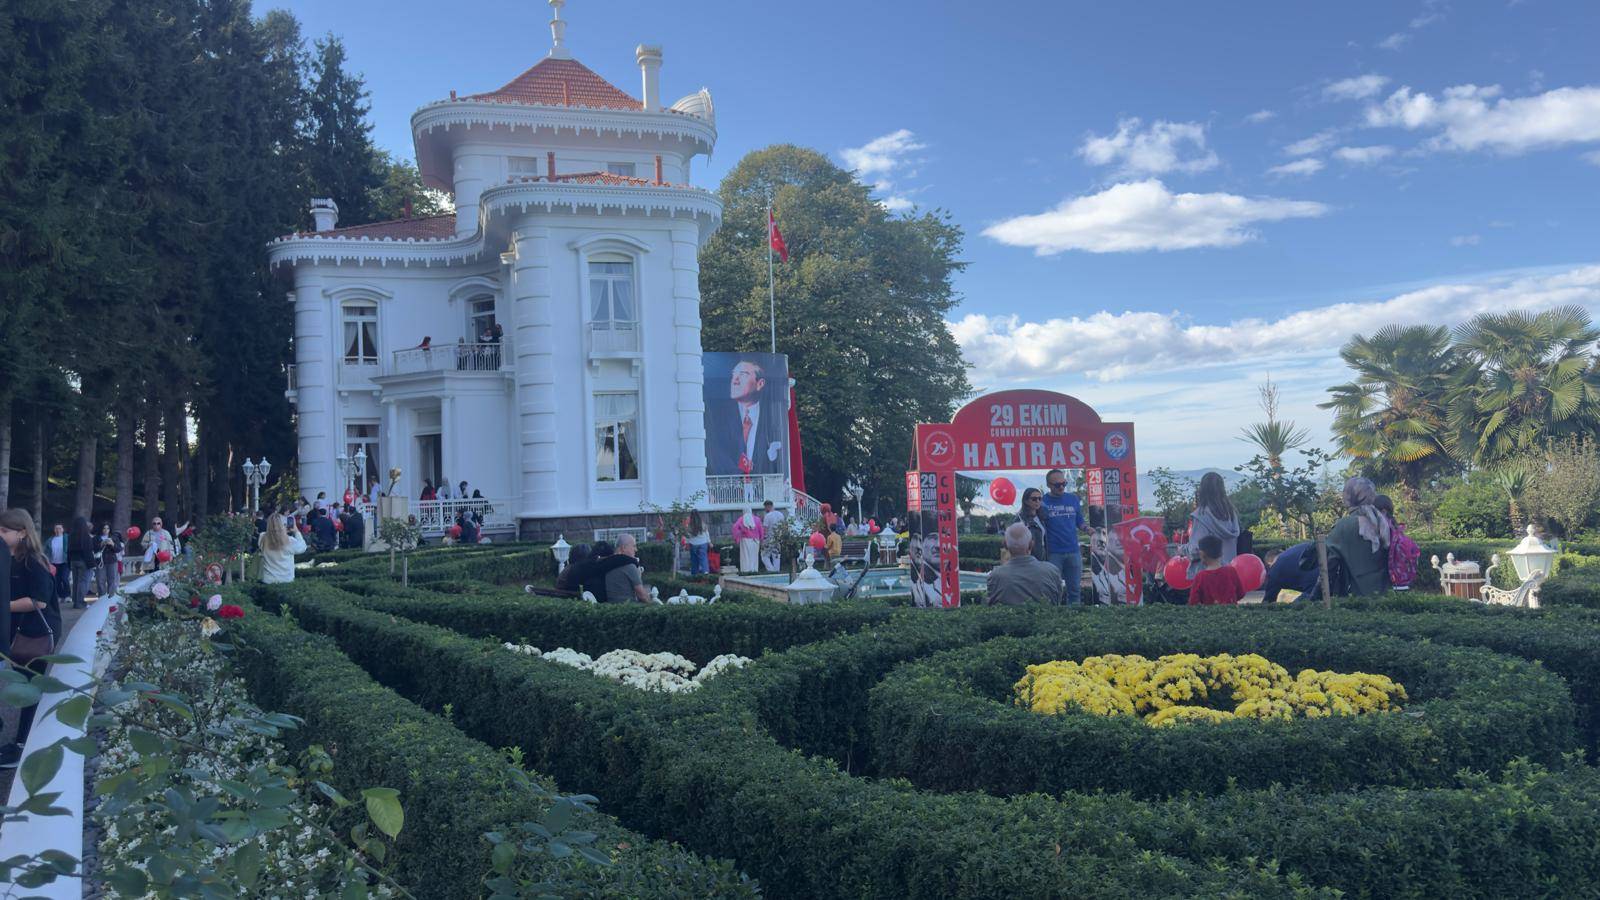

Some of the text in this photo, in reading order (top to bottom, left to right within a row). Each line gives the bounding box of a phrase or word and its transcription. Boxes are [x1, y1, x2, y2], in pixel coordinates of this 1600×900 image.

[990, 404, 1014, 426] 29
[963, 441, 1097, 468] HATIRASI
[907, 473, 919, 488] 29
[920, 473, 937, 488] 29
[1088, 470, 1102, 484] 29
[1104, 469, 1120, 484] 29
